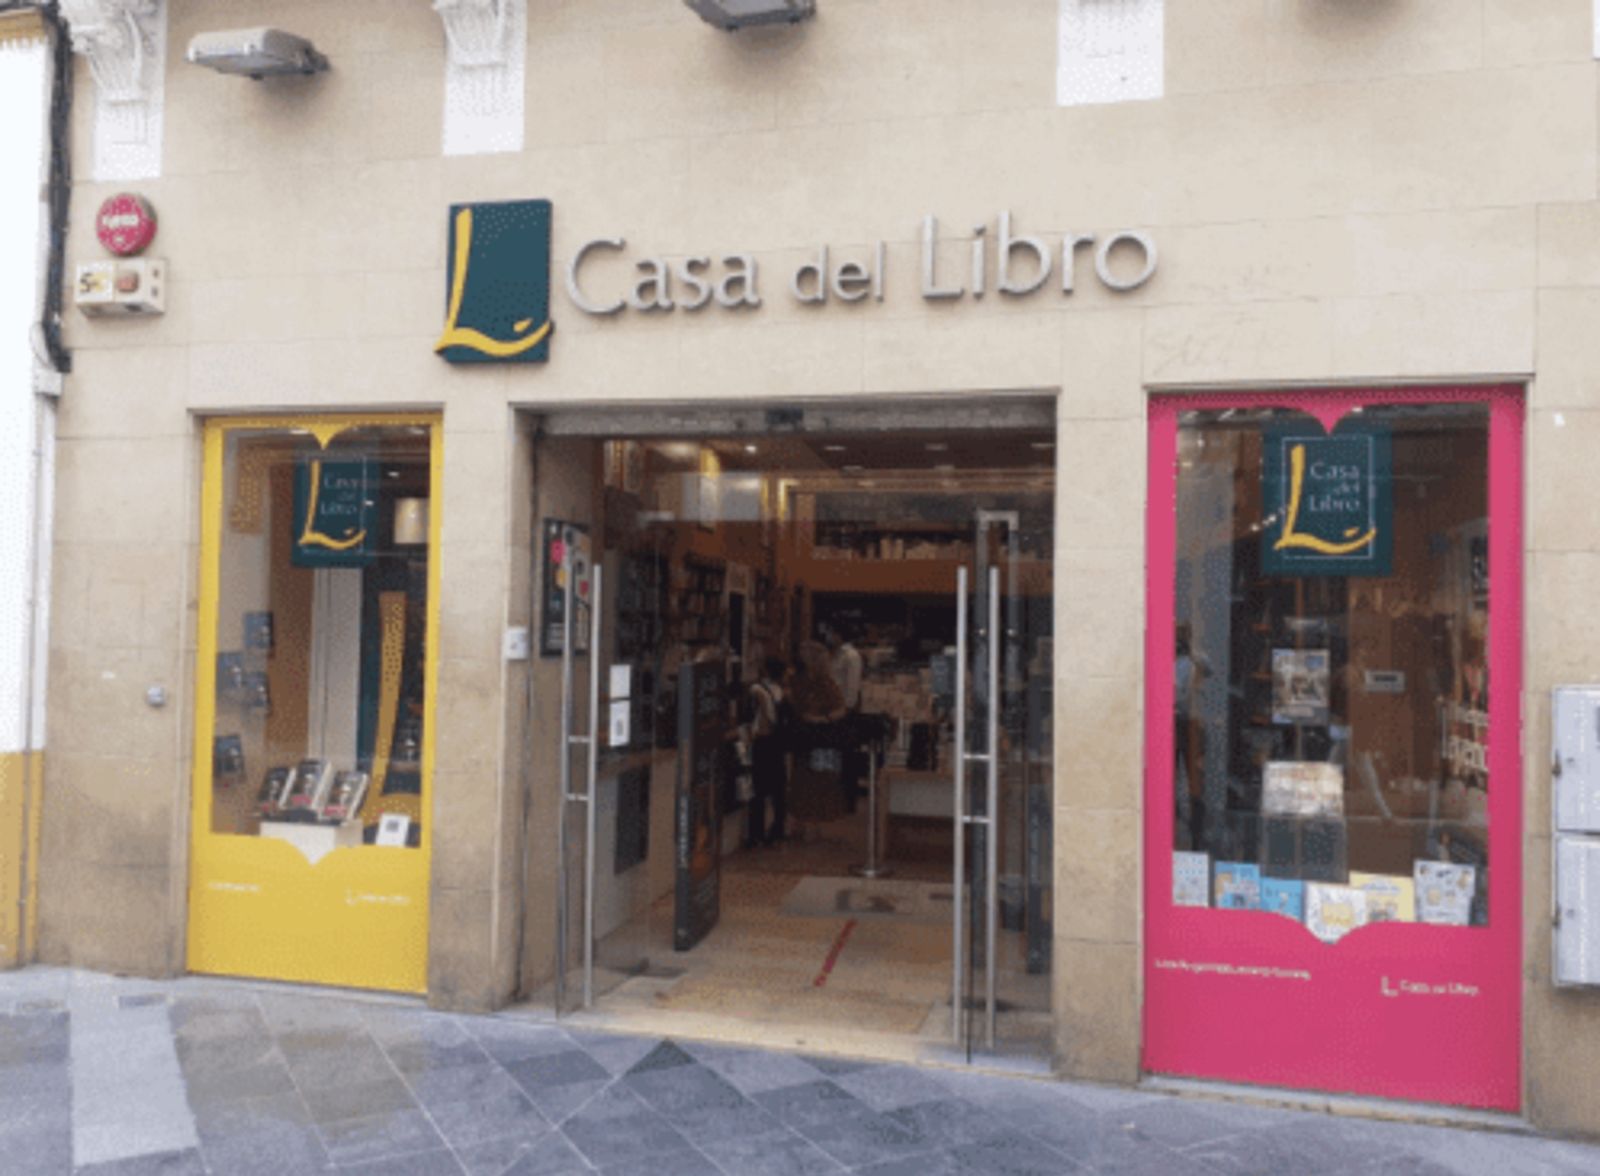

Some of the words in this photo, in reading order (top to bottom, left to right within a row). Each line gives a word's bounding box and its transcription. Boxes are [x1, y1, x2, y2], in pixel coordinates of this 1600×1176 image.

[565, 236, 763, 316] Casa
[789, 240, 884, 304] del
[922, 209, 1159, 300] Libro
[1309, 461, 1360, 479] Casa
[1309, 495, 1360, 512] Libro
